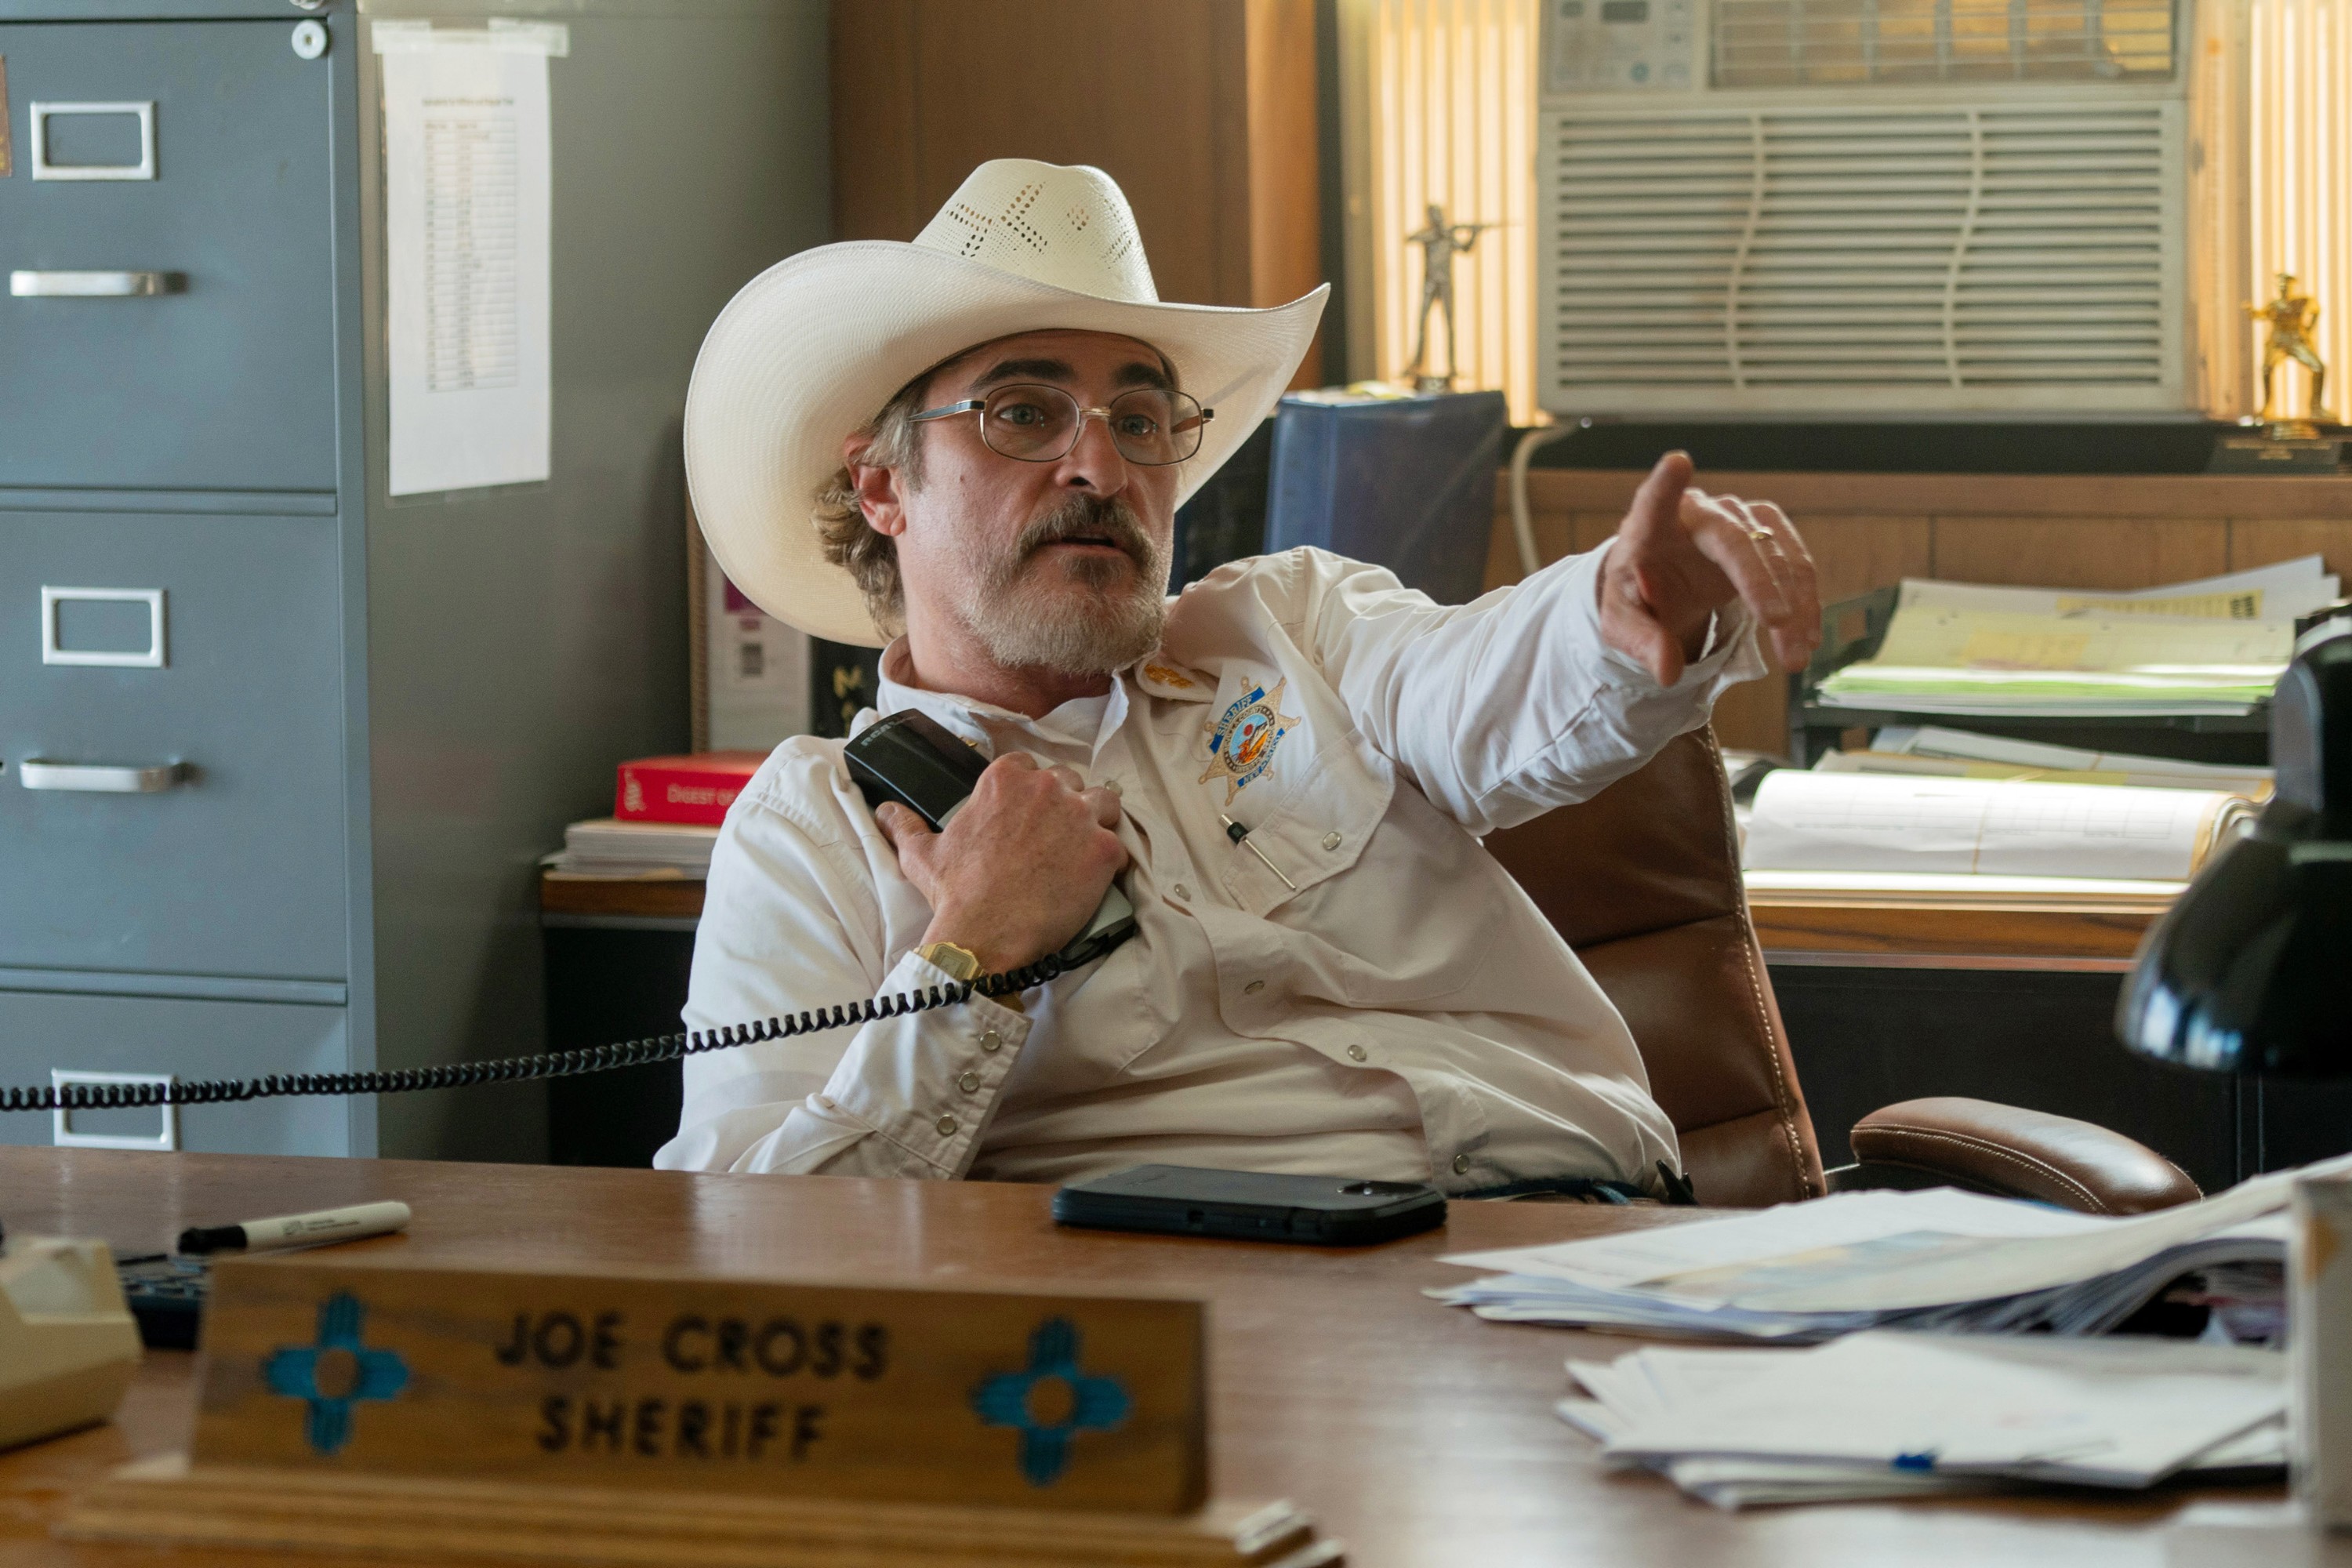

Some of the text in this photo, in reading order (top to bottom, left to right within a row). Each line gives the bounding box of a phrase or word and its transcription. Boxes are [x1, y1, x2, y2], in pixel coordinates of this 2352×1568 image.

[1217, 695, 1254, 736] SHERIFF
[495, 1312, 890, 1382] JOE CROSS
[536, 1396, 825, 1462] SHERIFF
